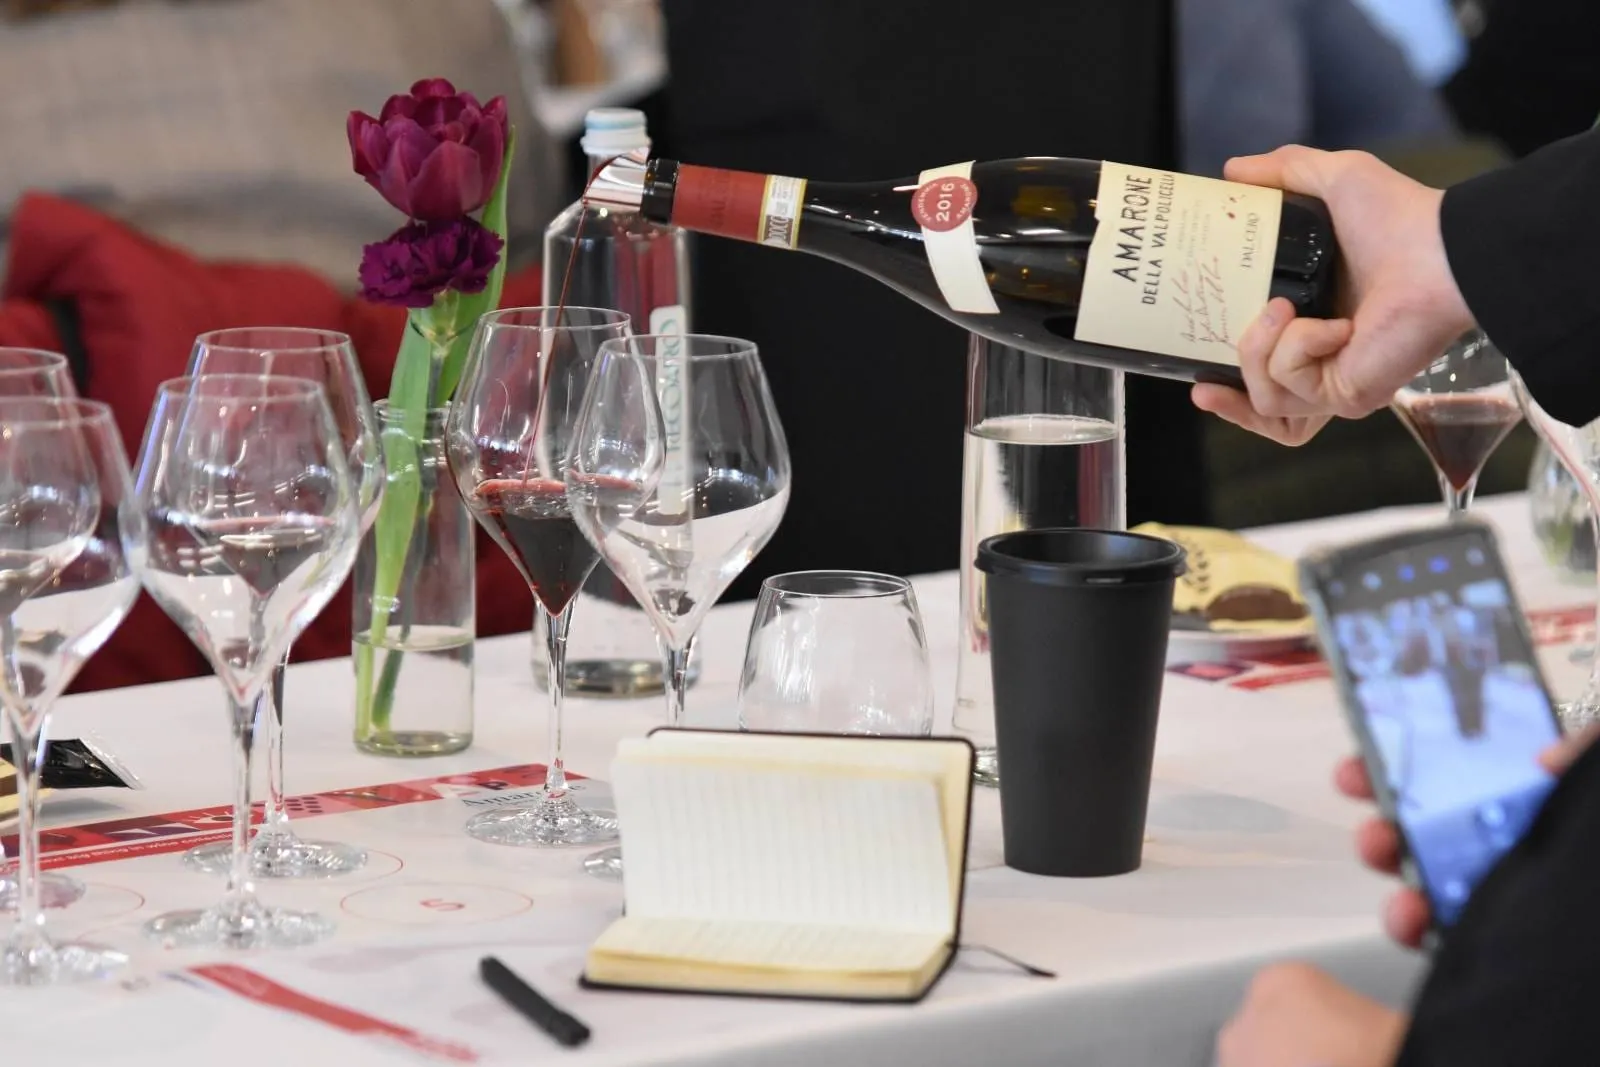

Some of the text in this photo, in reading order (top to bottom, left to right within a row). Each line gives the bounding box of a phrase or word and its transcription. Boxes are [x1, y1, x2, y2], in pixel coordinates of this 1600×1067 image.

[935, 182, 955, 222] 2016
[1112, 174, 1152, 282] AMARONE
[1140, 174, 1175, 306] DELLA VALPOLICELLA
